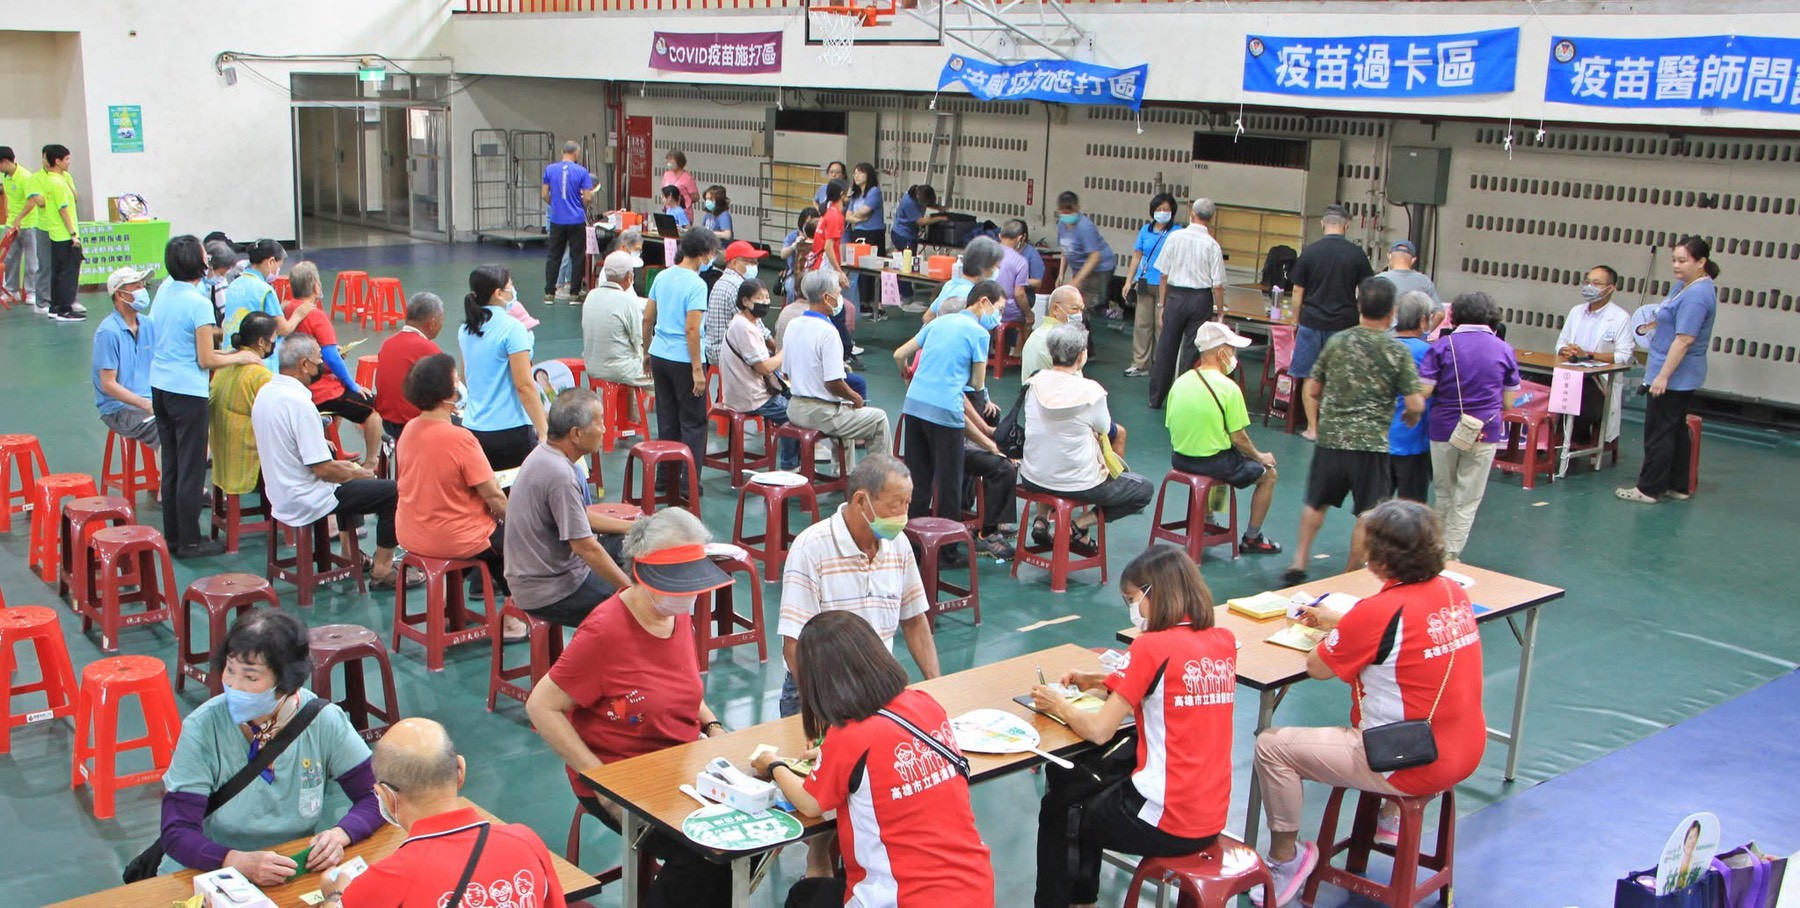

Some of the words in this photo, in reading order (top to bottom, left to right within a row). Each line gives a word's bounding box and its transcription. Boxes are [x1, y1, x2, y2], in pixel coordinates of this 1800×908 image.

[669, 42, 777, 67] COVID疫苗施打區
[1275, 40, 1479, 90] 疫苗過卡區
